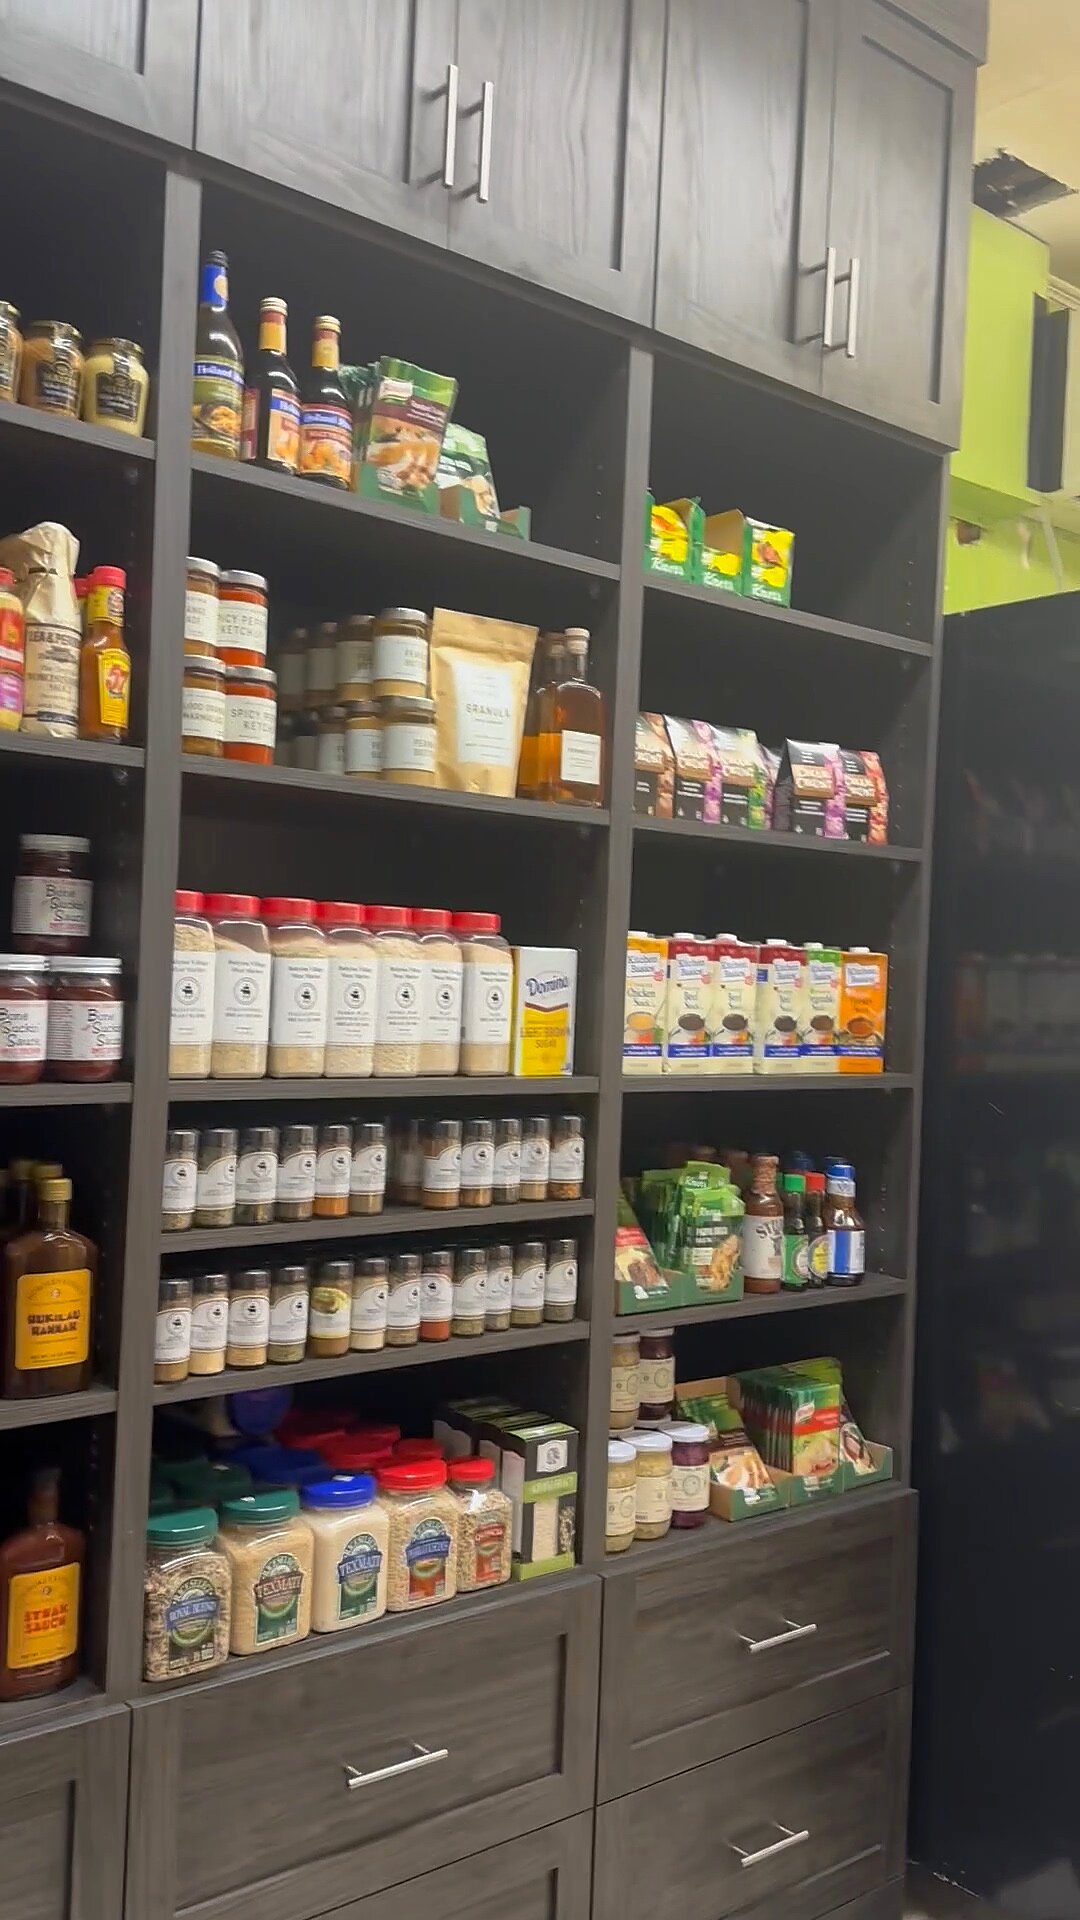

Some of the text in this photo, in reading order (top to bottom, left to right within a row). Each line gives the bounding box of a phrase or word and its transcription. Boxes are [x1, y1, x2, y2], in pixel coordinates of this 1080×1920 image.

[628, 955, 658, 965] Kitchen
[526, 975, 569, 997] Domino
[24, 1603, 69, 1621] STEAK
[24, 1616, 66, 1634] SAUCE
